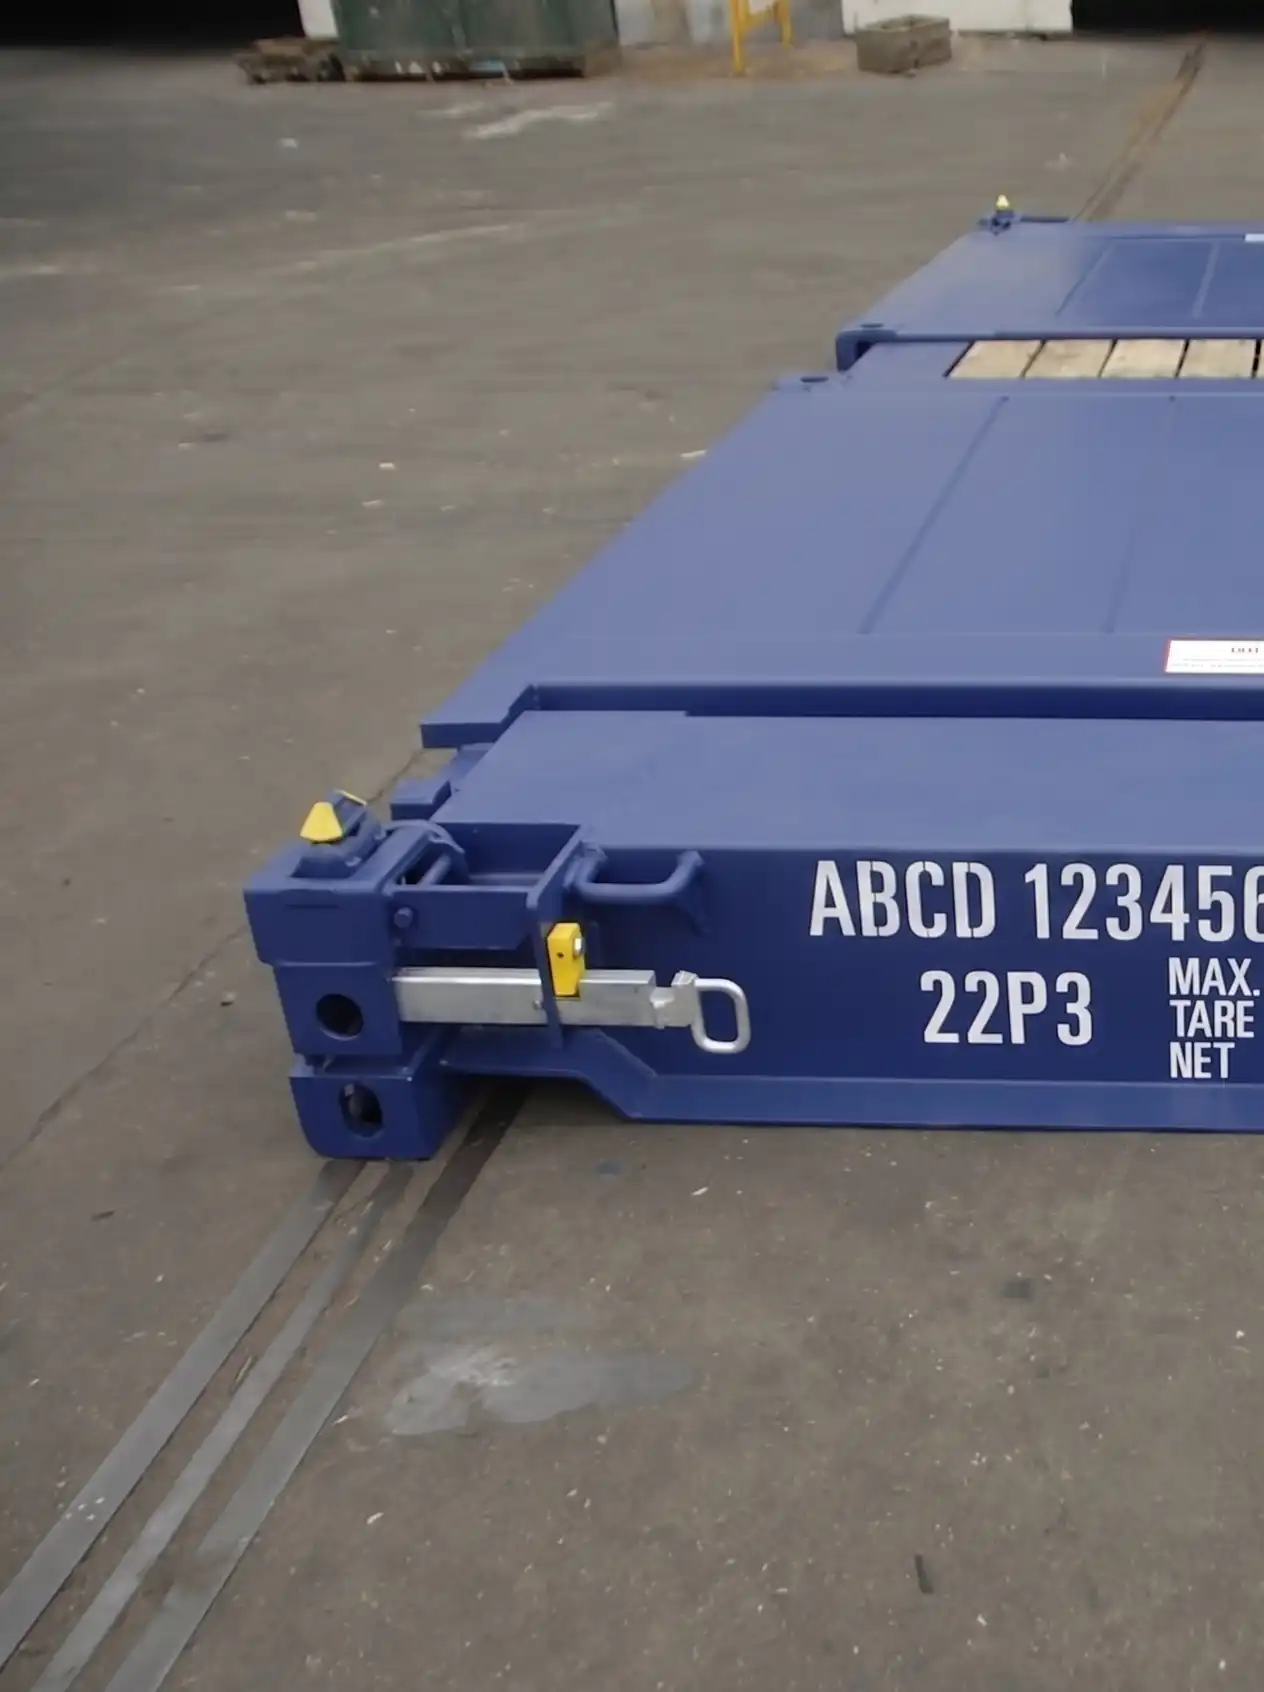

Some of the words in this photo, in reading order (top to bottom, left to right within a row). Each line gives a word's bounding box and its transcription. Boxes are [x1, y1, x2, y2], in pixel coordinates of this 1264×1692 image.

[809, 860, 996, 939] ABCD
[1168, 956, 1261, 997] MAX.
[920, 969, 1093, 1046] 22P3
[1169, 999, 1255, 1039] TARE
[1169, 1041, 1236, 1079] NET
